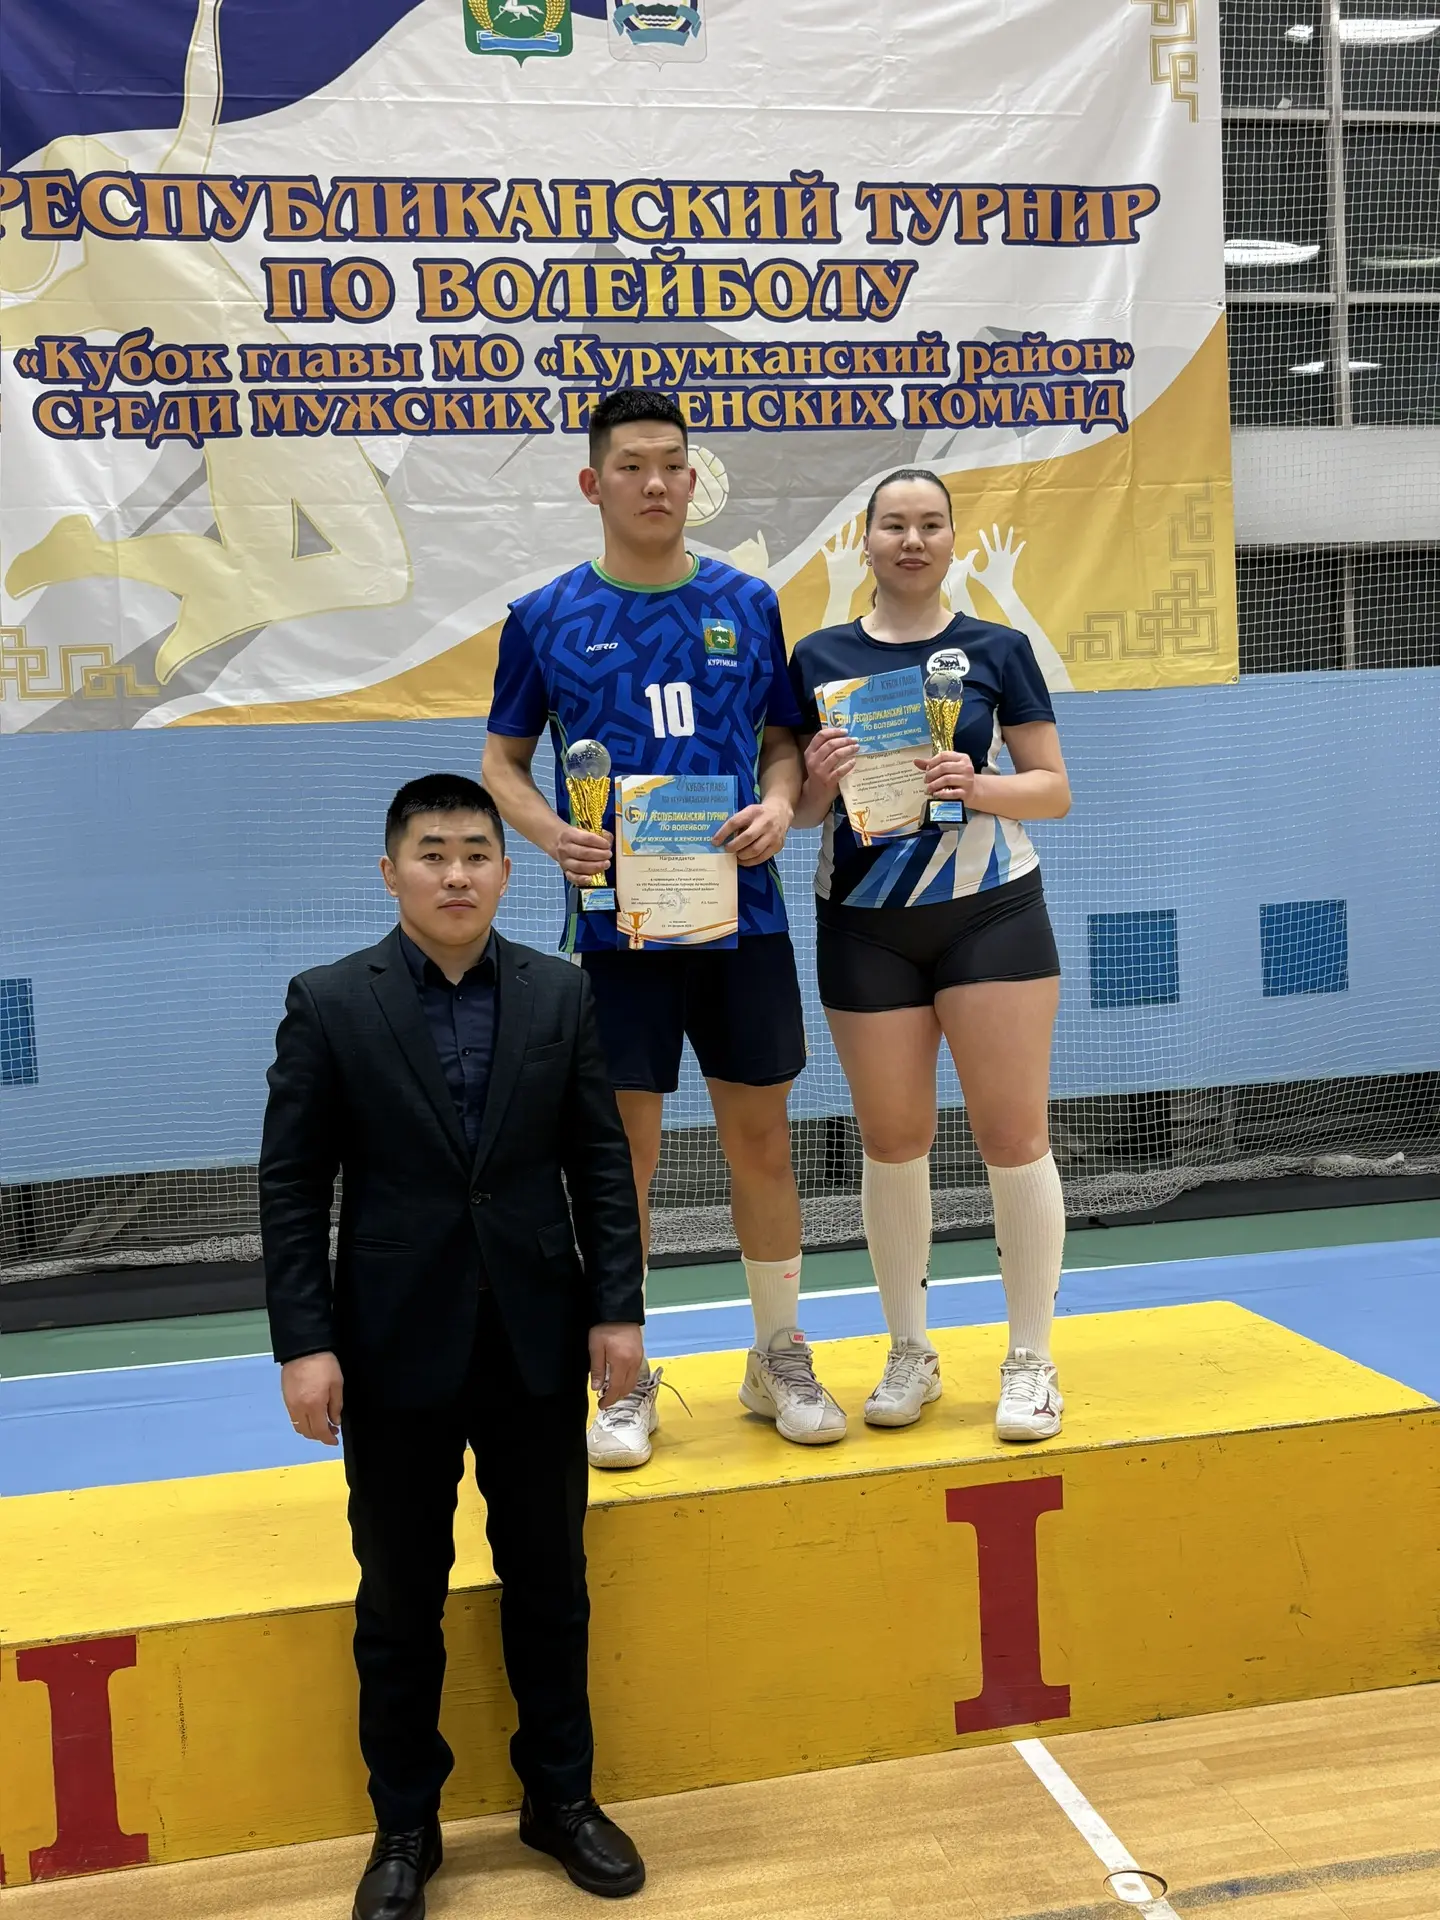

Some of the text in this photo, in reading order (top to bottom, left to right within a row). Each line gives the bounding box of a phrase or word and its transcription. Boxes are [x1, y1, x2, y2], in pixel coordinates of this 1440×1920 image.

[855, 182, 1160, 247] ТУРНИР
[261, 246, 918, 323] ПО ВОЛЕЙБОЛУ
[15, 327, 1134, 391] «Кубок главы МО «Курумканский район»
[33, 388, 242, 449] СРЕДИ
[251, 387, 552, 437] МУЖСКИХ
[667, 385, 897, 432] ЕНСКИХ
[902, 381, 1130, 435] КОМАНД
[586, 642, 618, 653] NERO
[707, 659, 738, 668] КУРУМКАН
[645, 682, 696, 739] 10
[945, 1474, 1071, 1735] I
[0, 1635, 149, 1883] I
